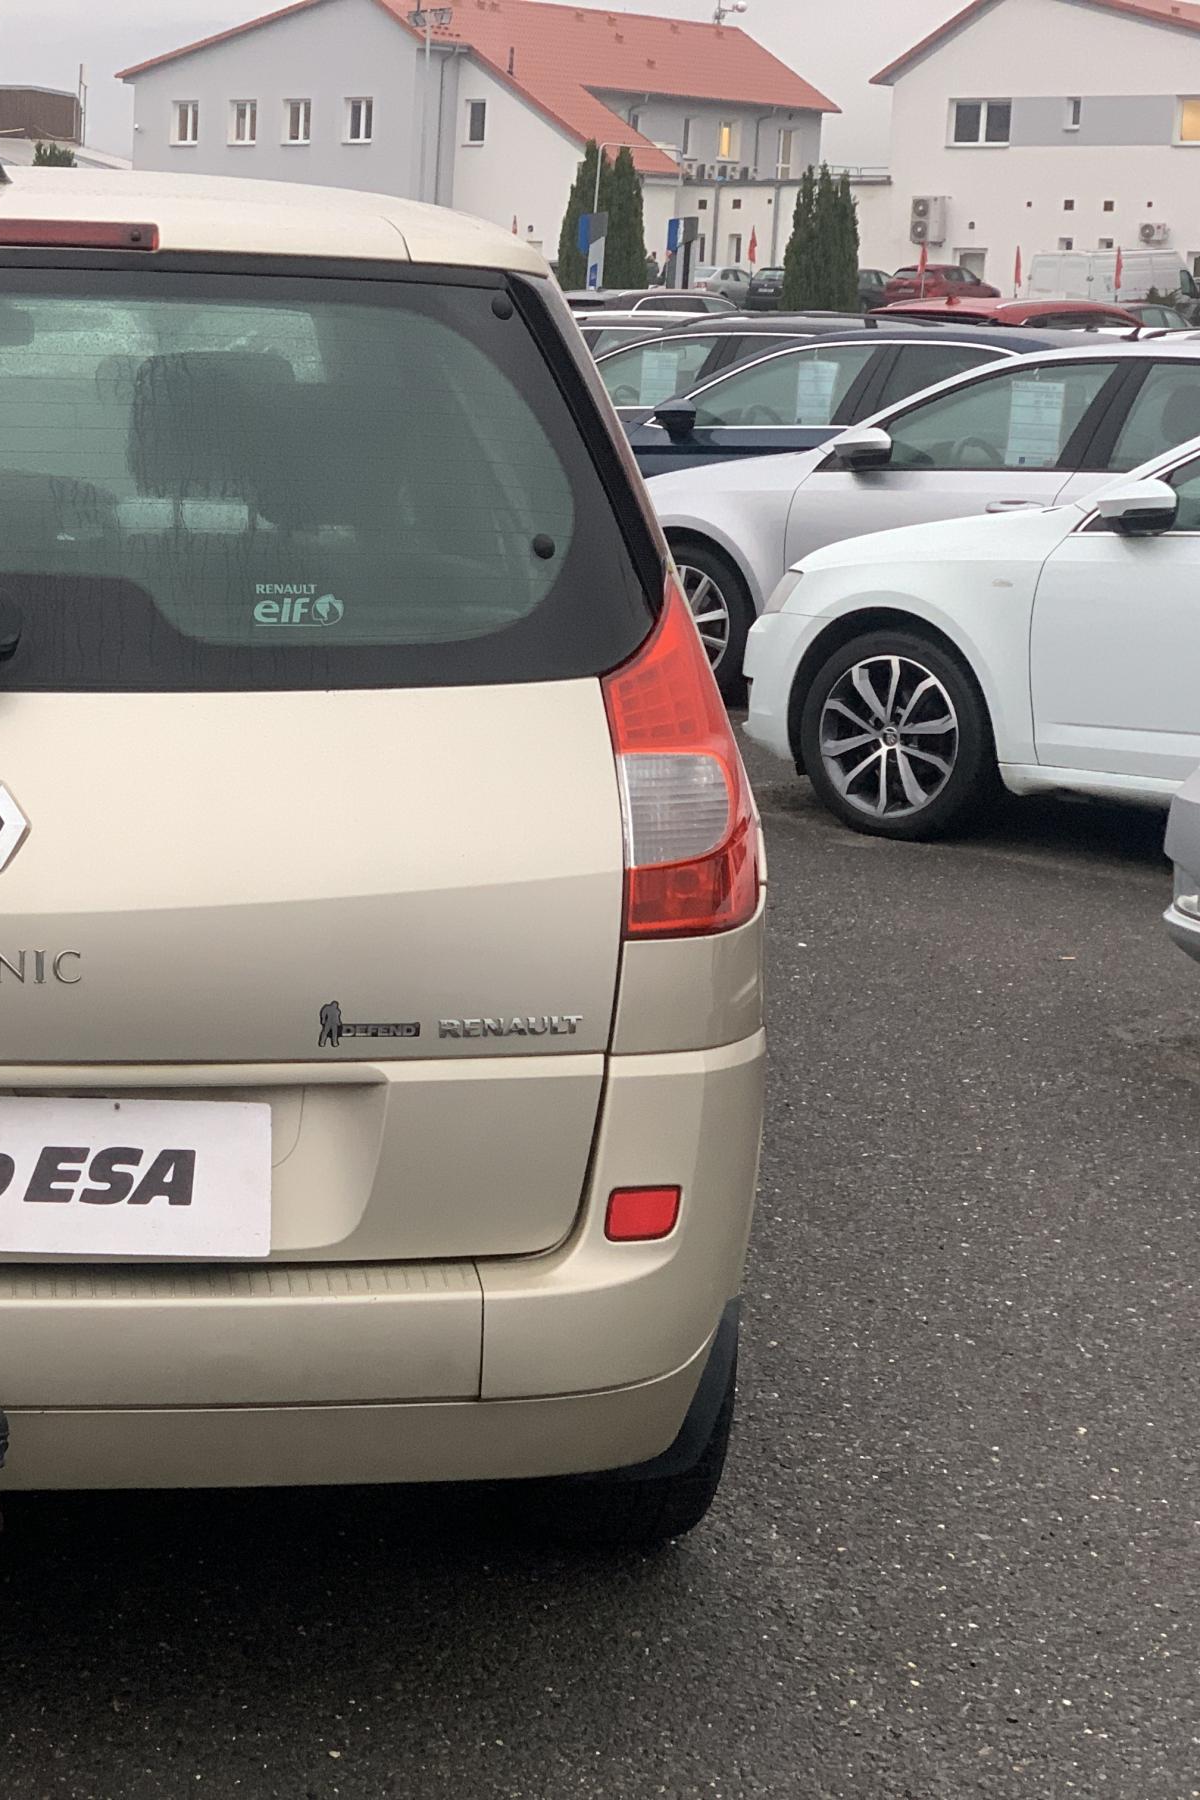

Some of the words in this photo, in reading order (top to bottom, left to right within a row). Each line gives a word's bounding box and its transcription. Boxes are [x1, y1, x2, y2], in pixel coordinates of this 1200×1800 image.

[255, 583, 317, 595] RENAULT
[253, 597, 310, 623] elf
[341, 1023, 418, 1037] DEFEND
[438, 1014, 584, 1039] RENAULT
[23, 1146, 197, 1206] ESA
